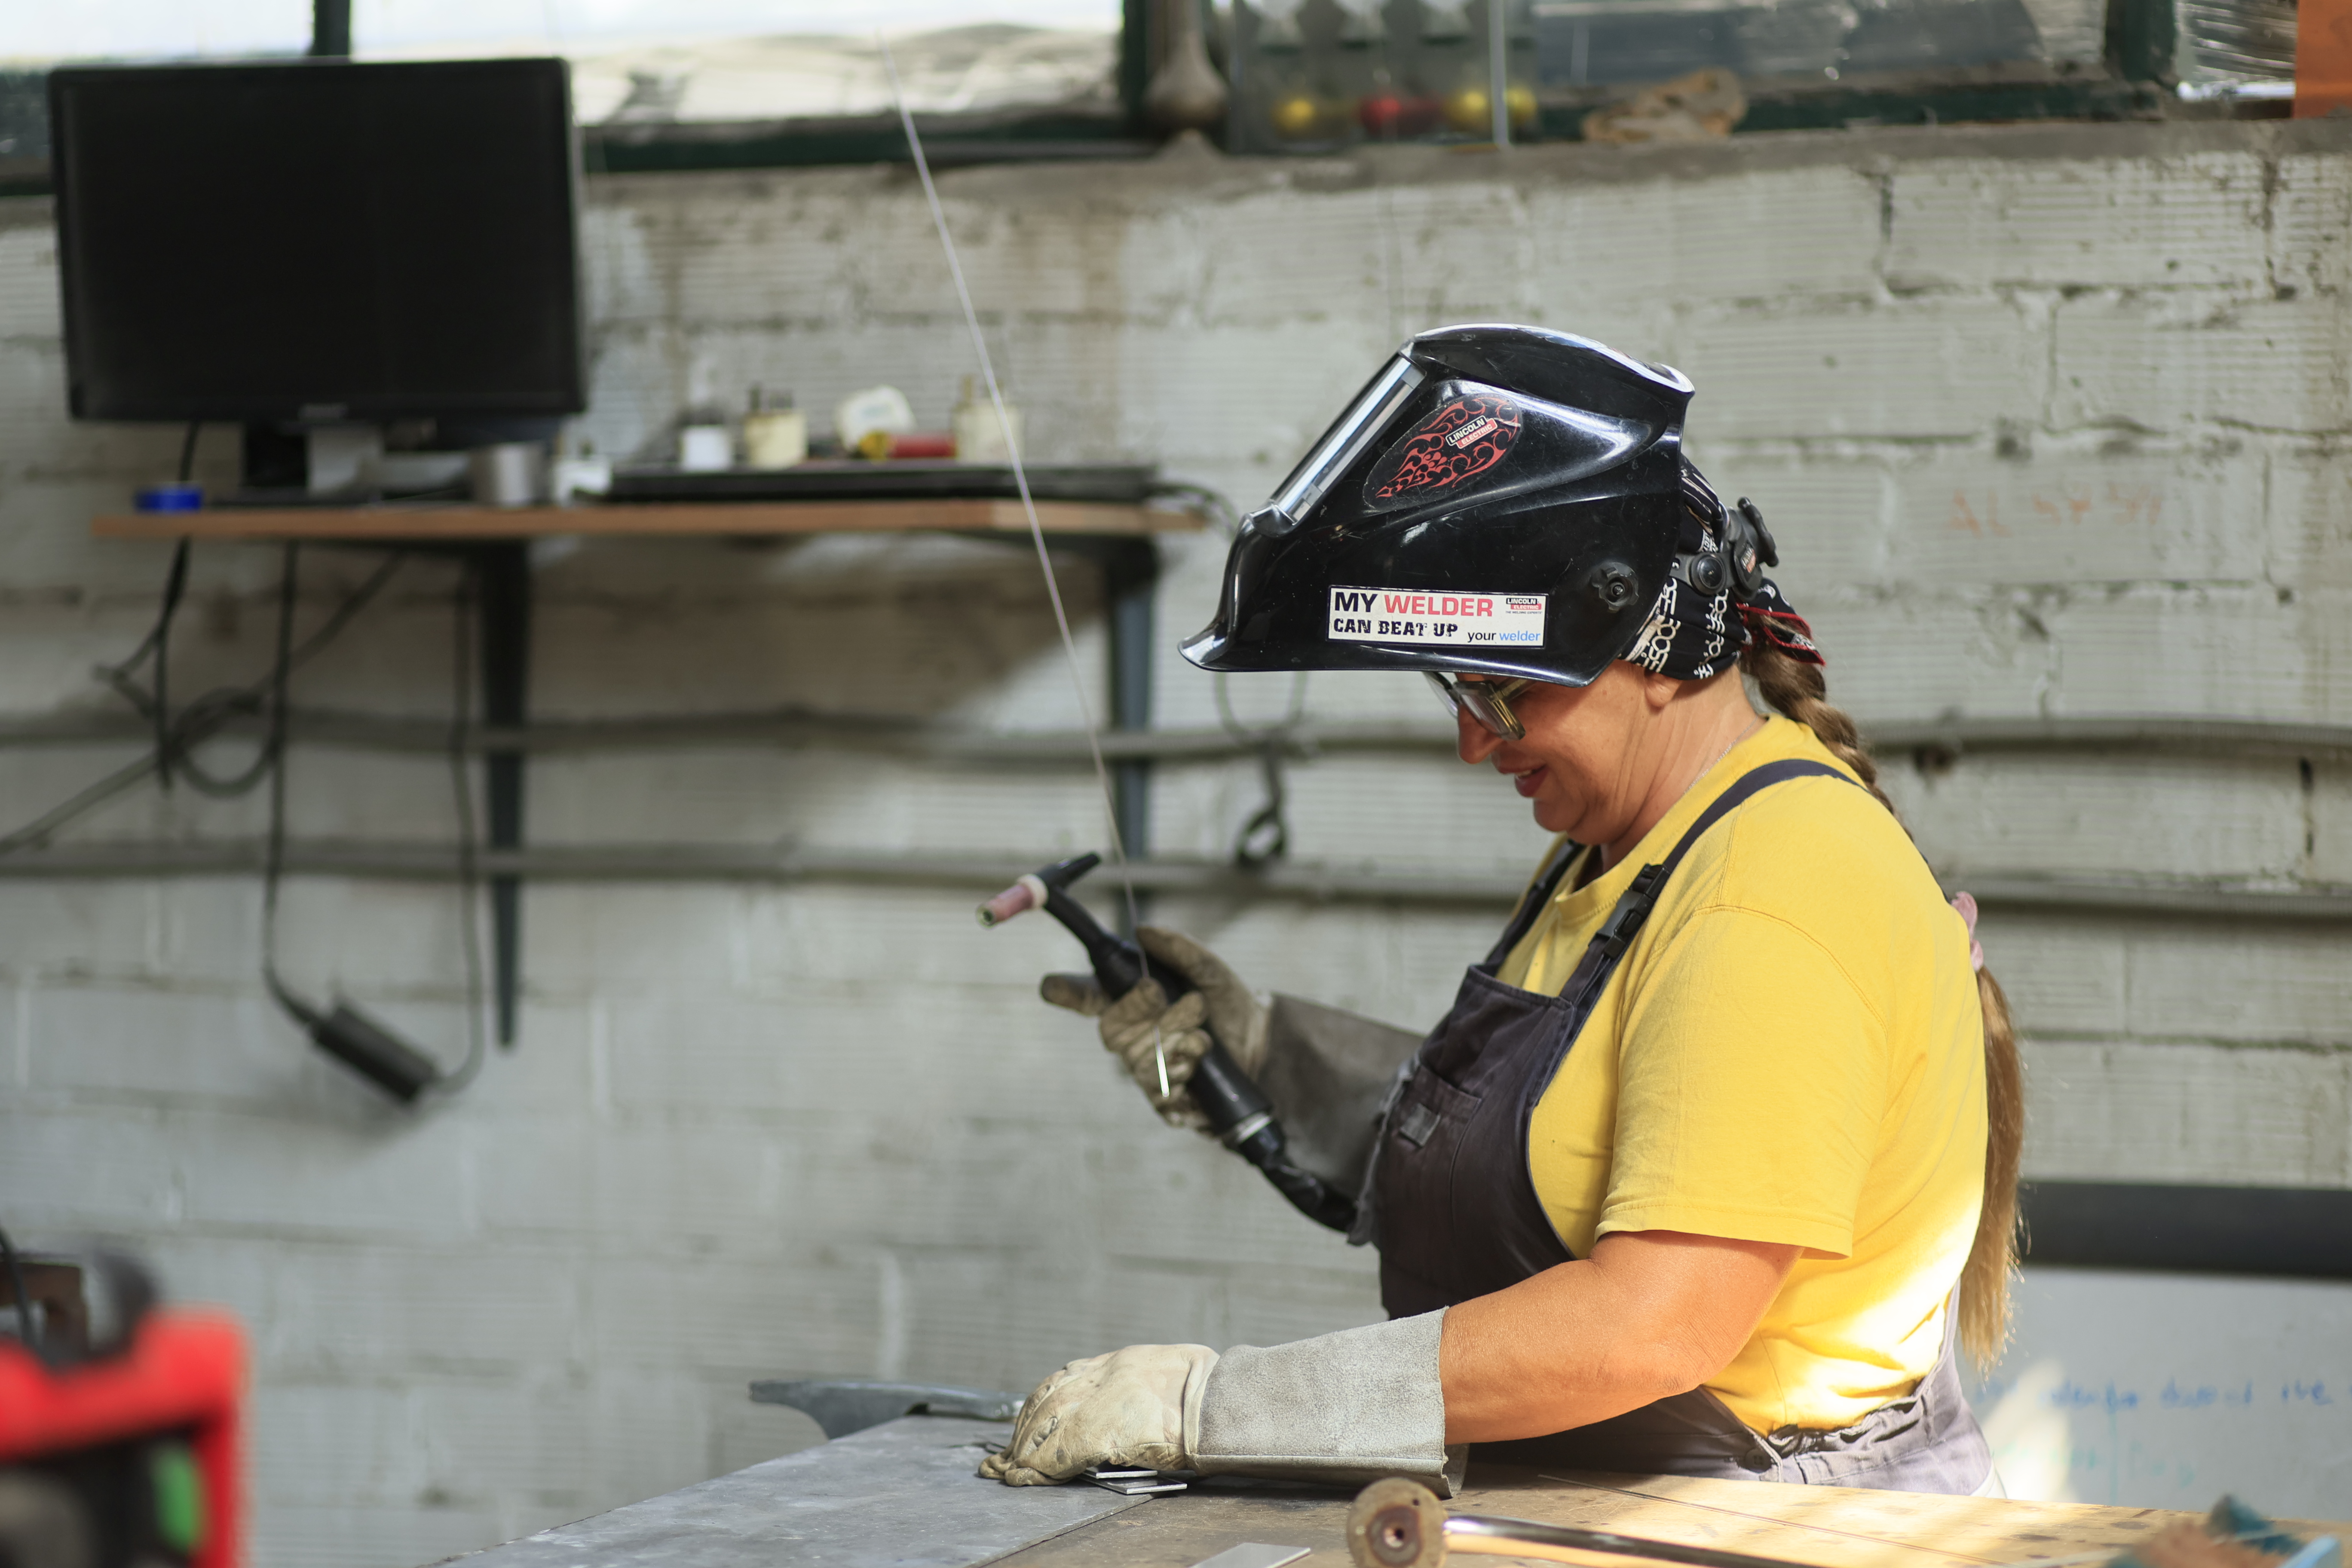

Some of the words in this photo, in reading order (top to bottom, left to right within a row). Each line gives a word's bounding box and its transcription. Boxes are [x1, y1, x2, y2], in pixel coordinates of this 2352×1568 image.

[1449, 418, 1485, 443] LINCOLN
[1461, 424, 1493, 445] ELECTRIC
[1334, 591, 1378, 612] MY
[1384, 594, 1493, 617] WELDER
[1333, 618, 1372, 634] CAN
[1378, 620, 1427, 636] BEAT
[1433, 622, 1458, 637] UP
[1467, 631, 1497, 643] your
[1499, 630, 1541, 642] welder
